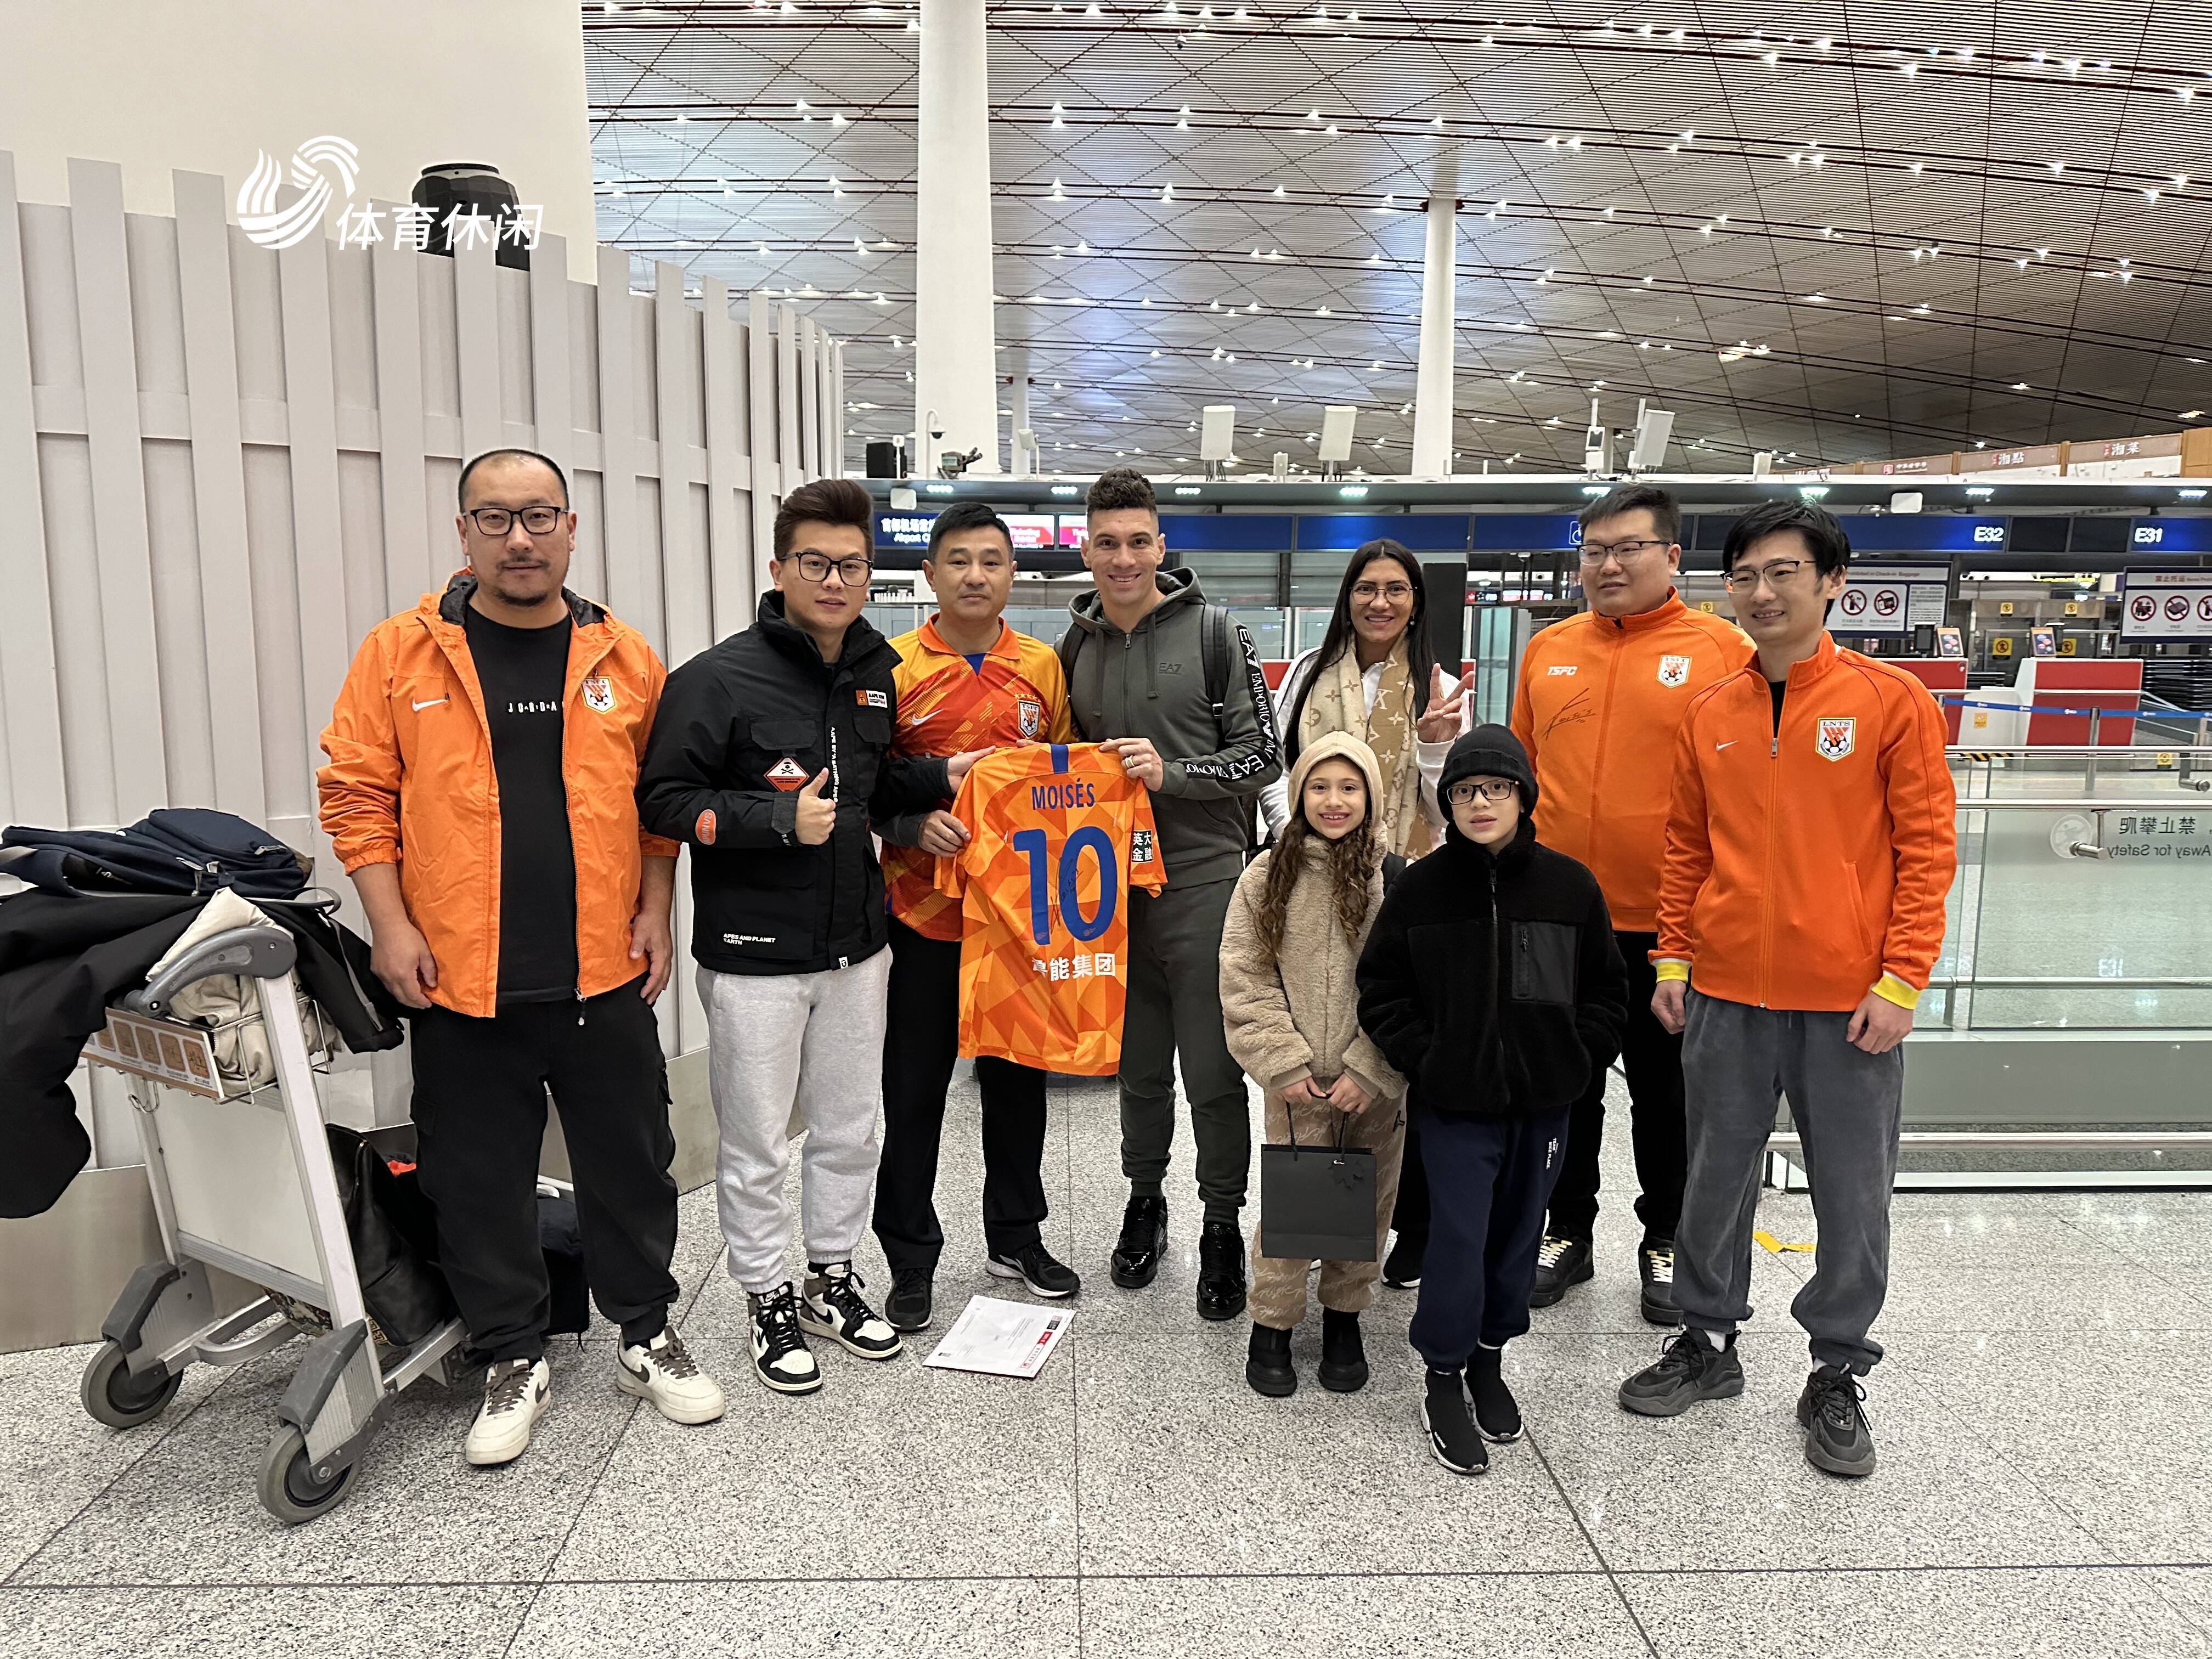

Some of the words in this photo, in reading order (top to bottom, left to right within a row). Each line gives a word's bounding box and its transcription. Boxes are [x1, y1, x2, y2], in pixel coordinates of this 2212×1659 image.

[1974, 526, 2004, 542] E32
[2135, 527, 2163, 543] E31
[1239, 628, 1261, 670] EA7
[1159, 662, 1183, 672] EA7
[1547, 665, 1578, 676] TSFC
[1229, 754, 1265, 780] EA7
[1031, 777, 1095, 810] MOISÉS
[1133, 831, 1152, 845] 英大
[1132, 847, 1153, 861] 金融
[1012, 826, 1118, 946] 10
